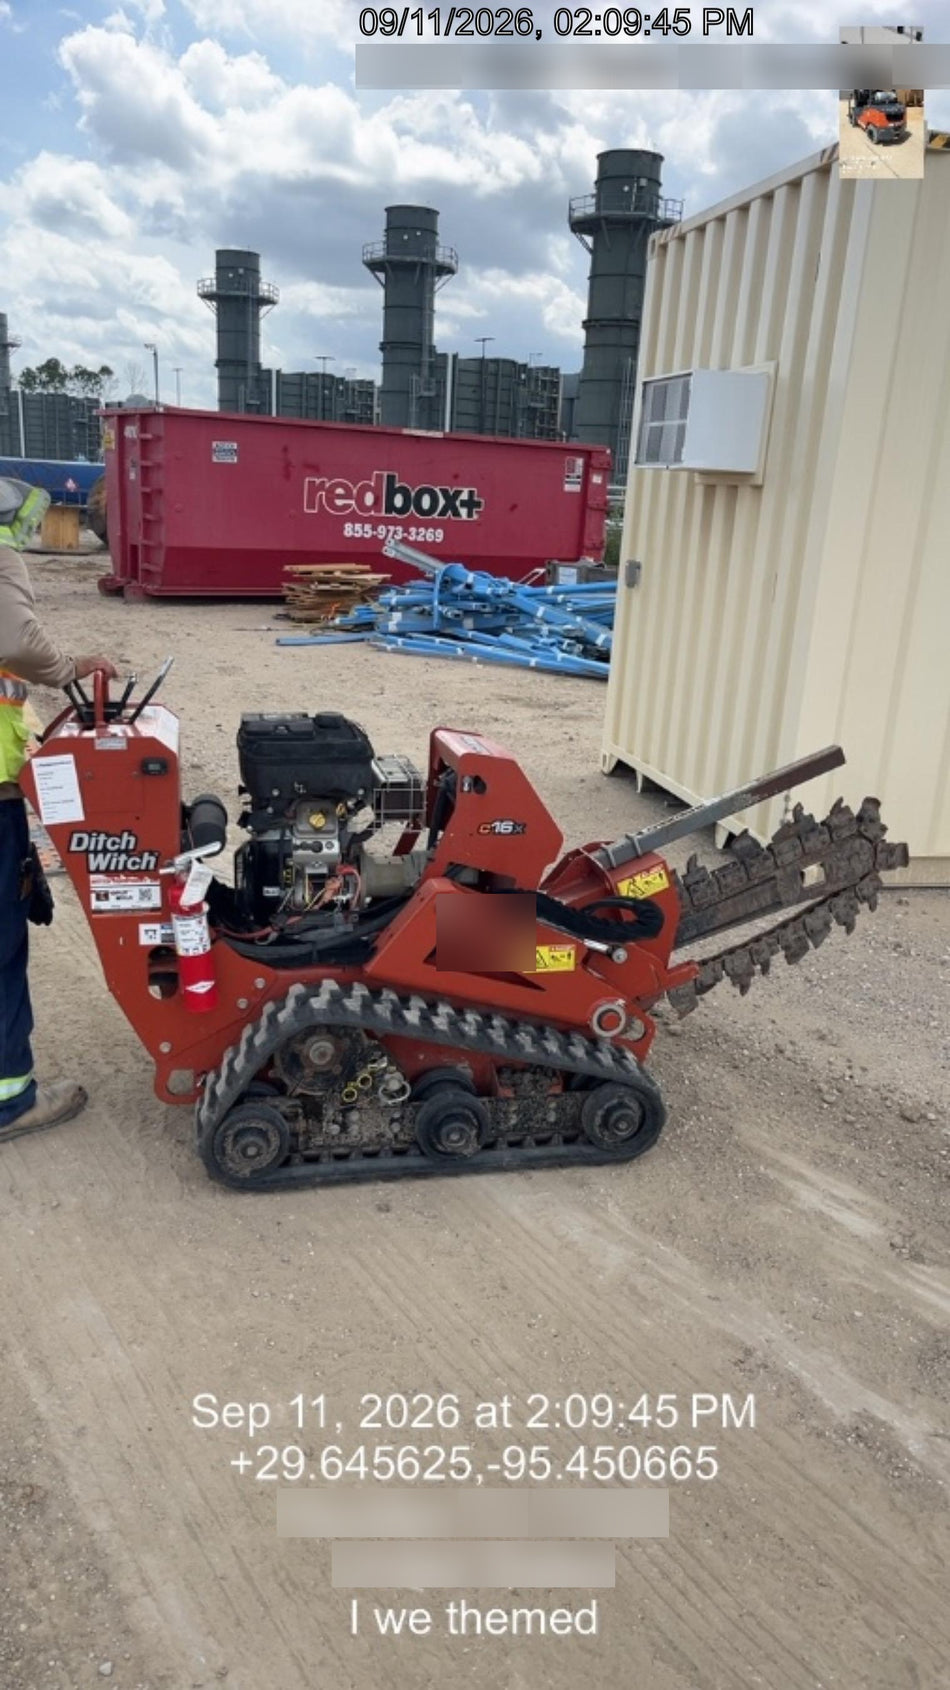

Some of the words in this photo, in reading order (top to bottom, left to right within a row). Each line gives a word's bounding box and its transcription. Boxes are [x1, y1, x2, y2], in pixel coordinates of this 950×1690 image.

[343, 522, 444, 543] 855-973-3269
[69, 831, 138, 852] Ditch
[87, 852, 157, 873] Witch
